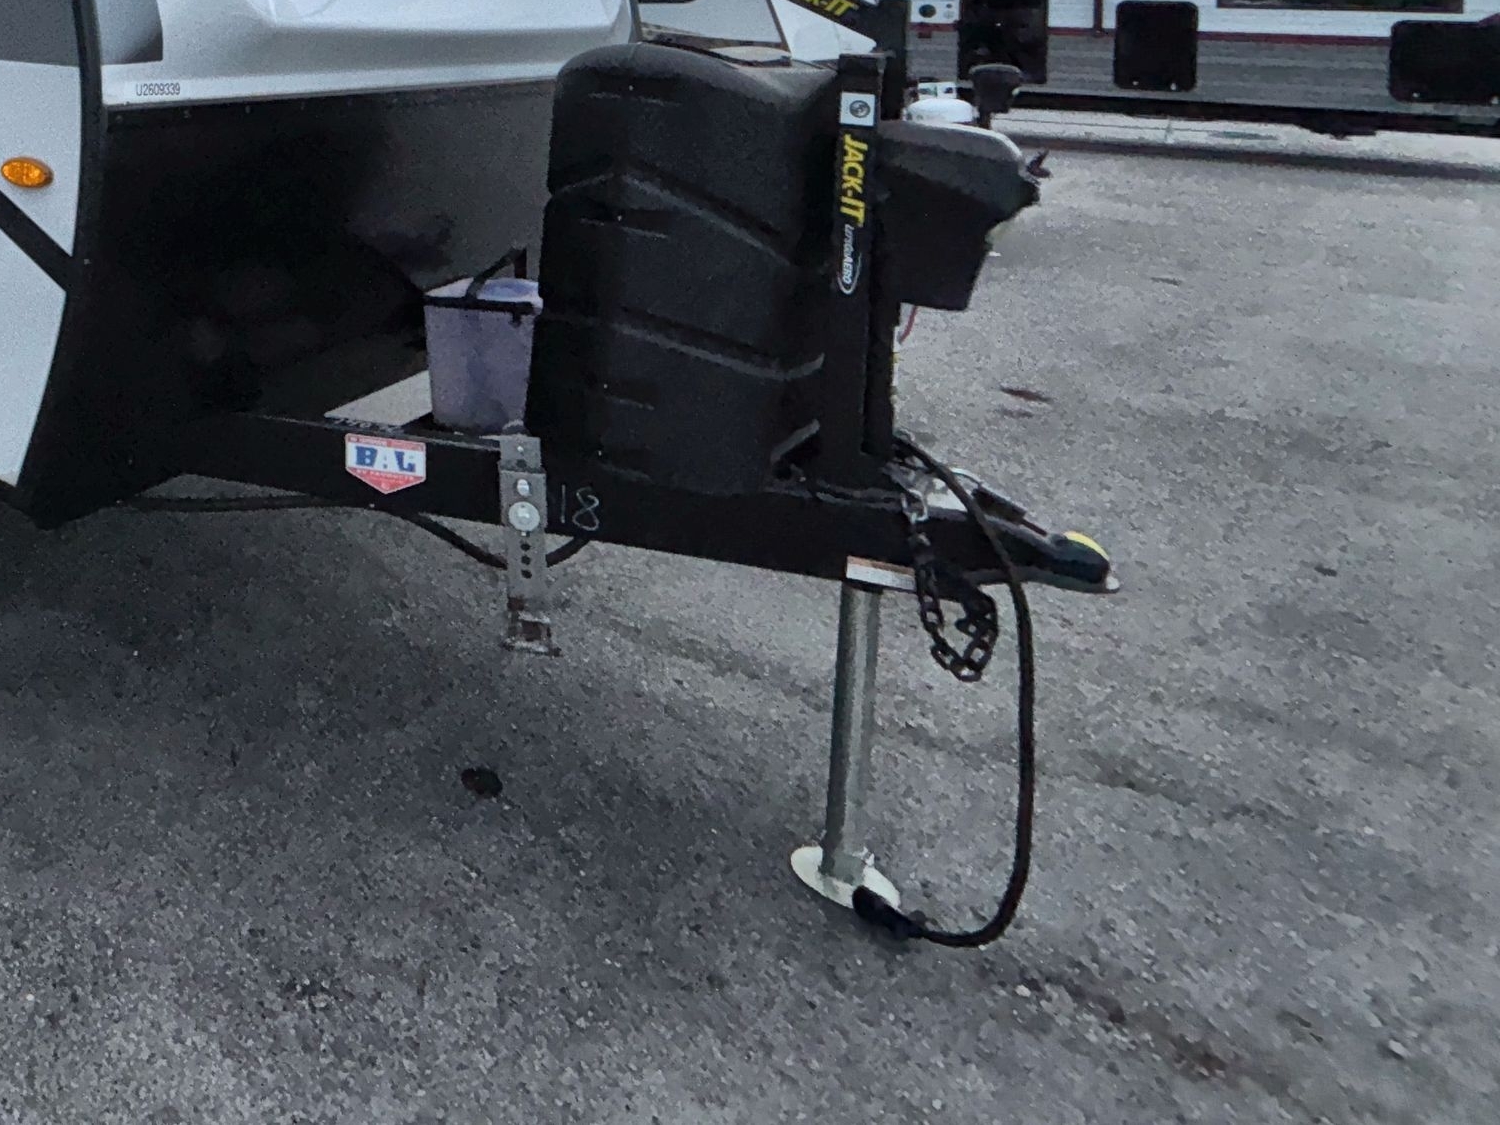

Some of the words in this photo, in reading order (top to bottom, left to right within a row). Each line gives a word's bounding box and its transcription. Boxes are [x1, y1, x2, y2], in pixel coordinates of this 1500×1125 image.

[135, 82, 181, 96] U2609339
[840, 134, 868, 227] JACK-IT
[354, 445, 416, 473] BAL
[560, 484, 600, 532] 18
